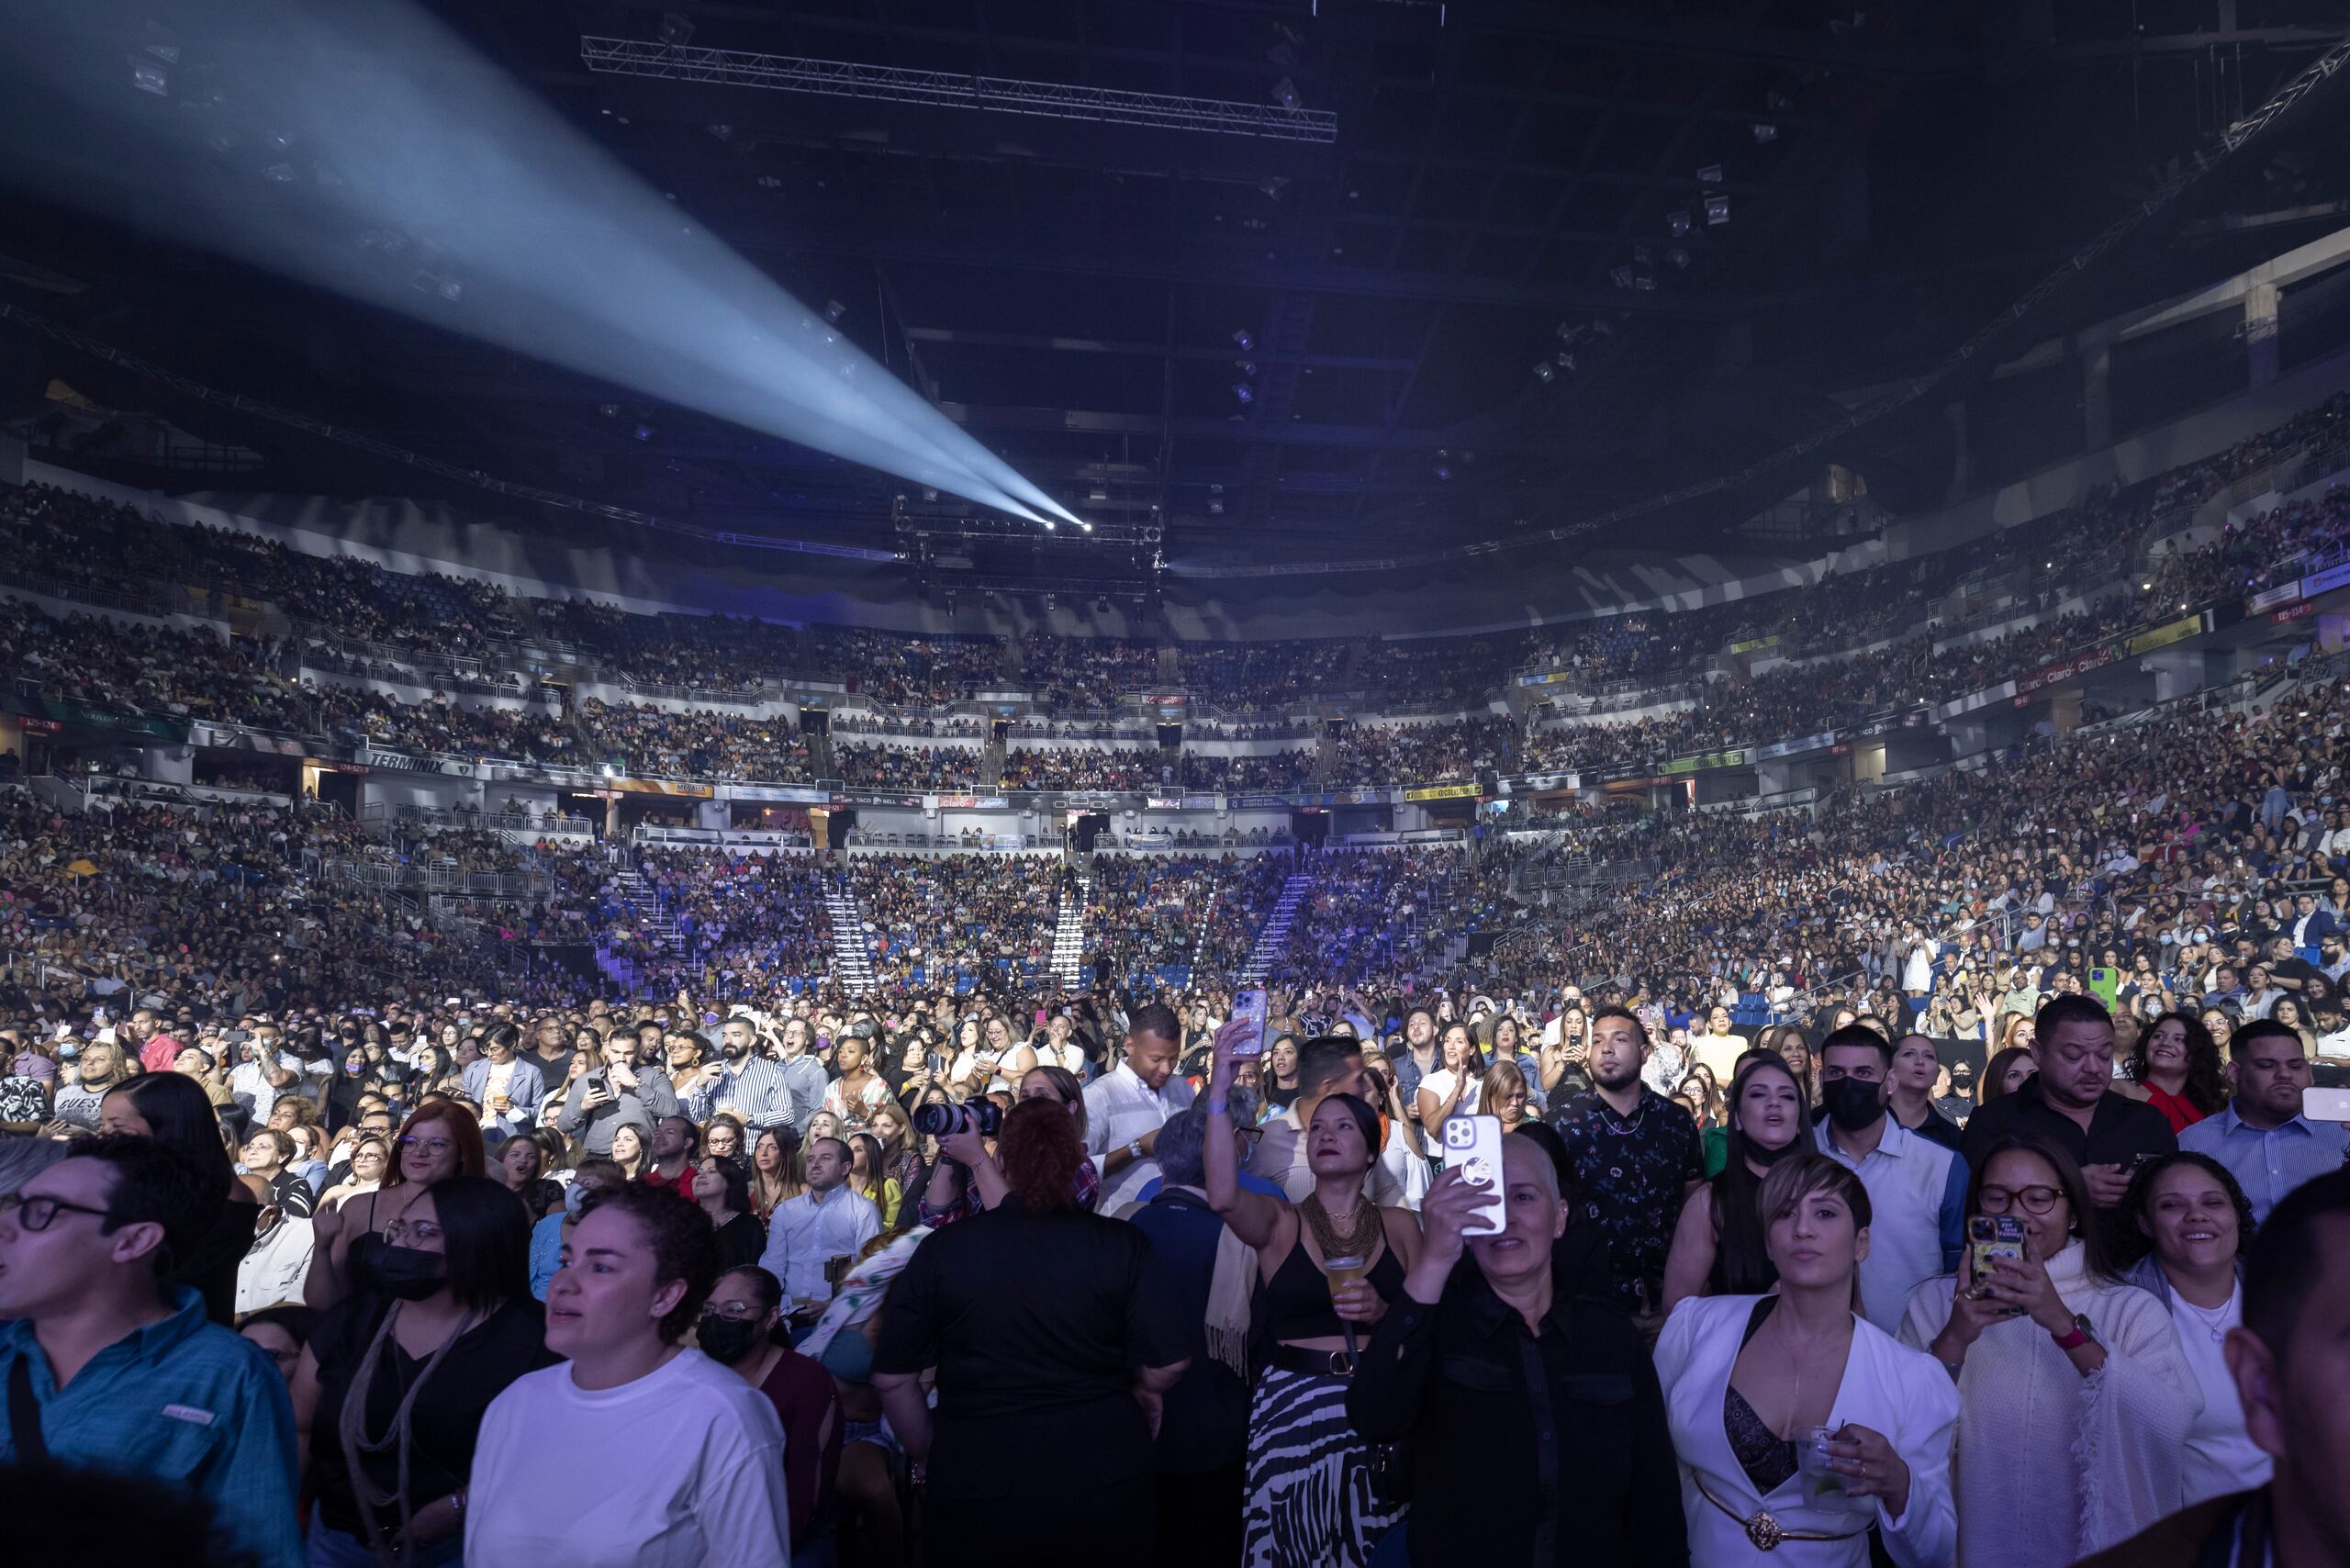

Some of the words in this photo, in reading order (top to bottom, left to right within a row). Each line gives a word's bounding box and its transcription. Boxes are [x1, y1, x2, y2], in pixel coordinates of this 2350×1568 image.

[2047, 666, 2072, 683] Claro
[2019, 678, 2042, 692] Claro
[371, 753, 445, 774] TERMINIX
[677, 784, 706, 793] MEDALLA
[59, 1098, 102, 1109] GUES
